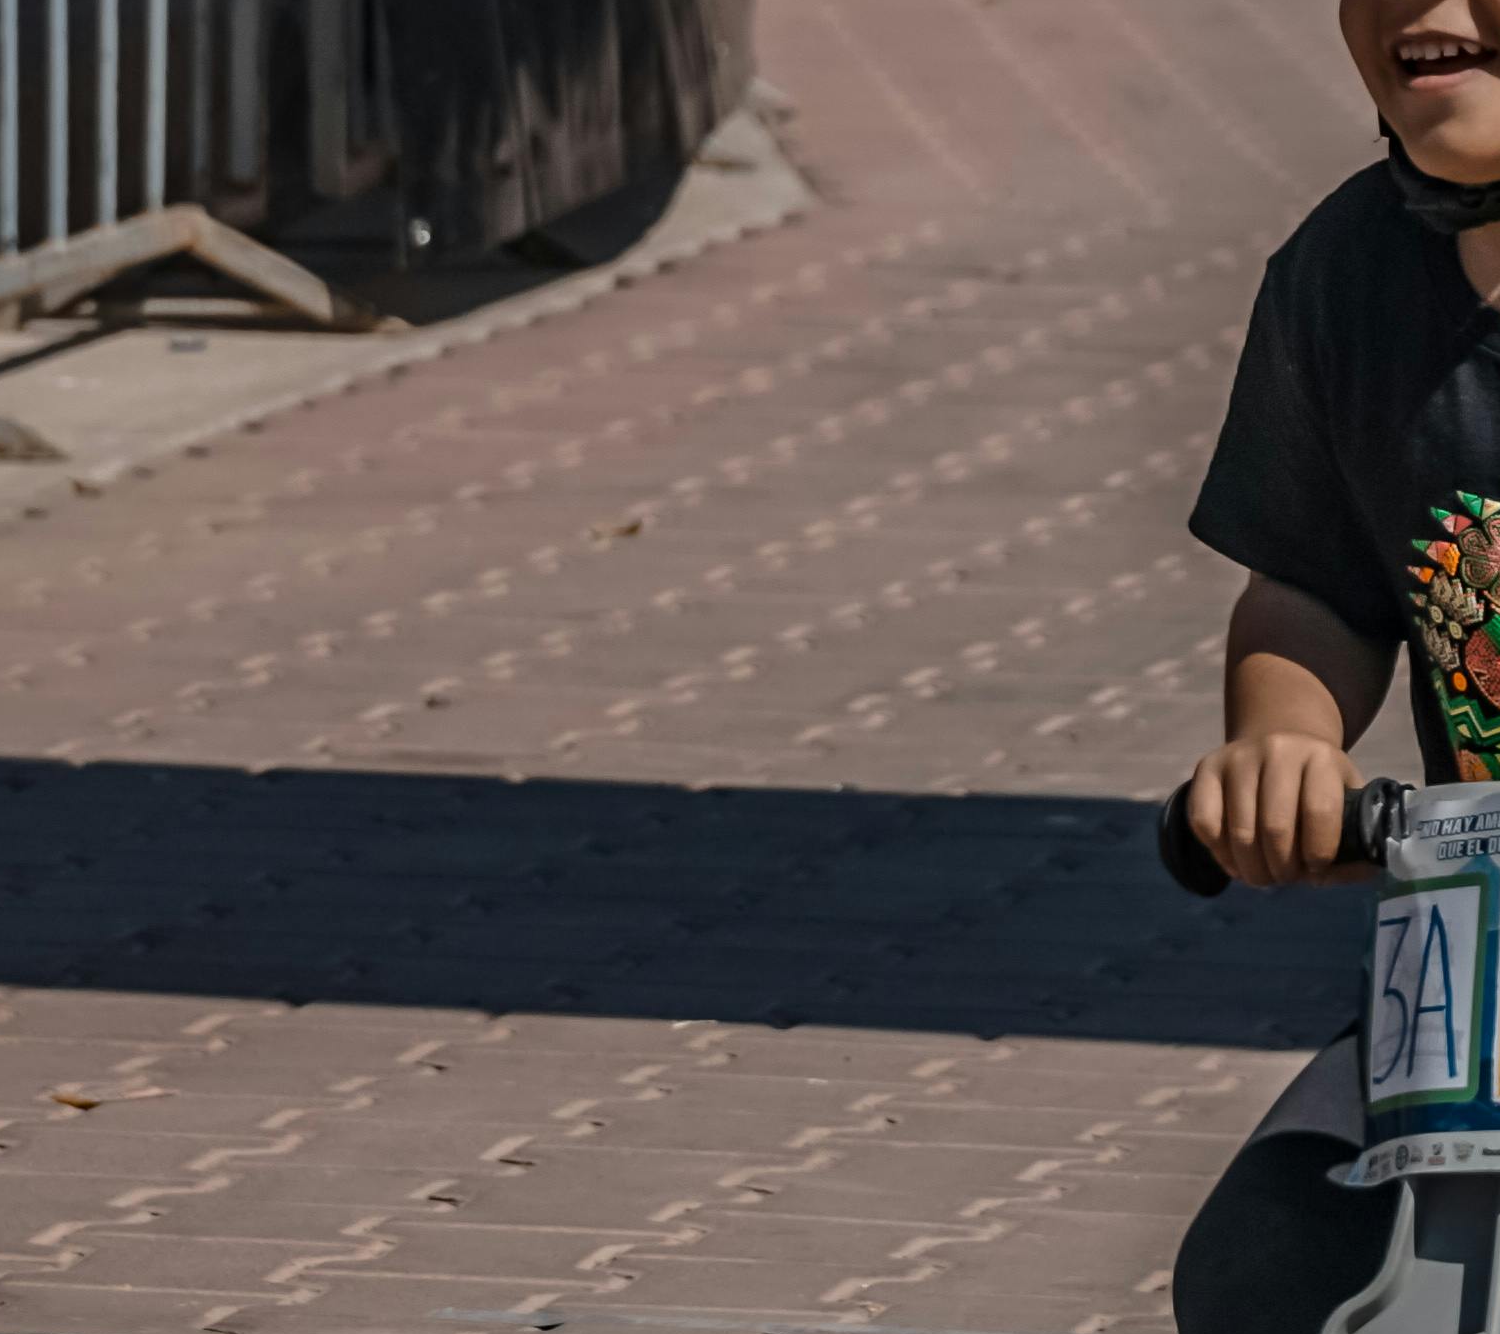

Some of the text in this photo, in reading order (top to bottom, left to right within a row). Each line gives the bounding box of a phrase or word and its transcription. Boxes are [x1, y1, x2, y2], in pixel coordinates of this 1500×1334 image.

[1440, 816, 1473, 835] HAY
[1436, 838, 1466, 860] QUE
[1466, 836, 1486, 857] EL
